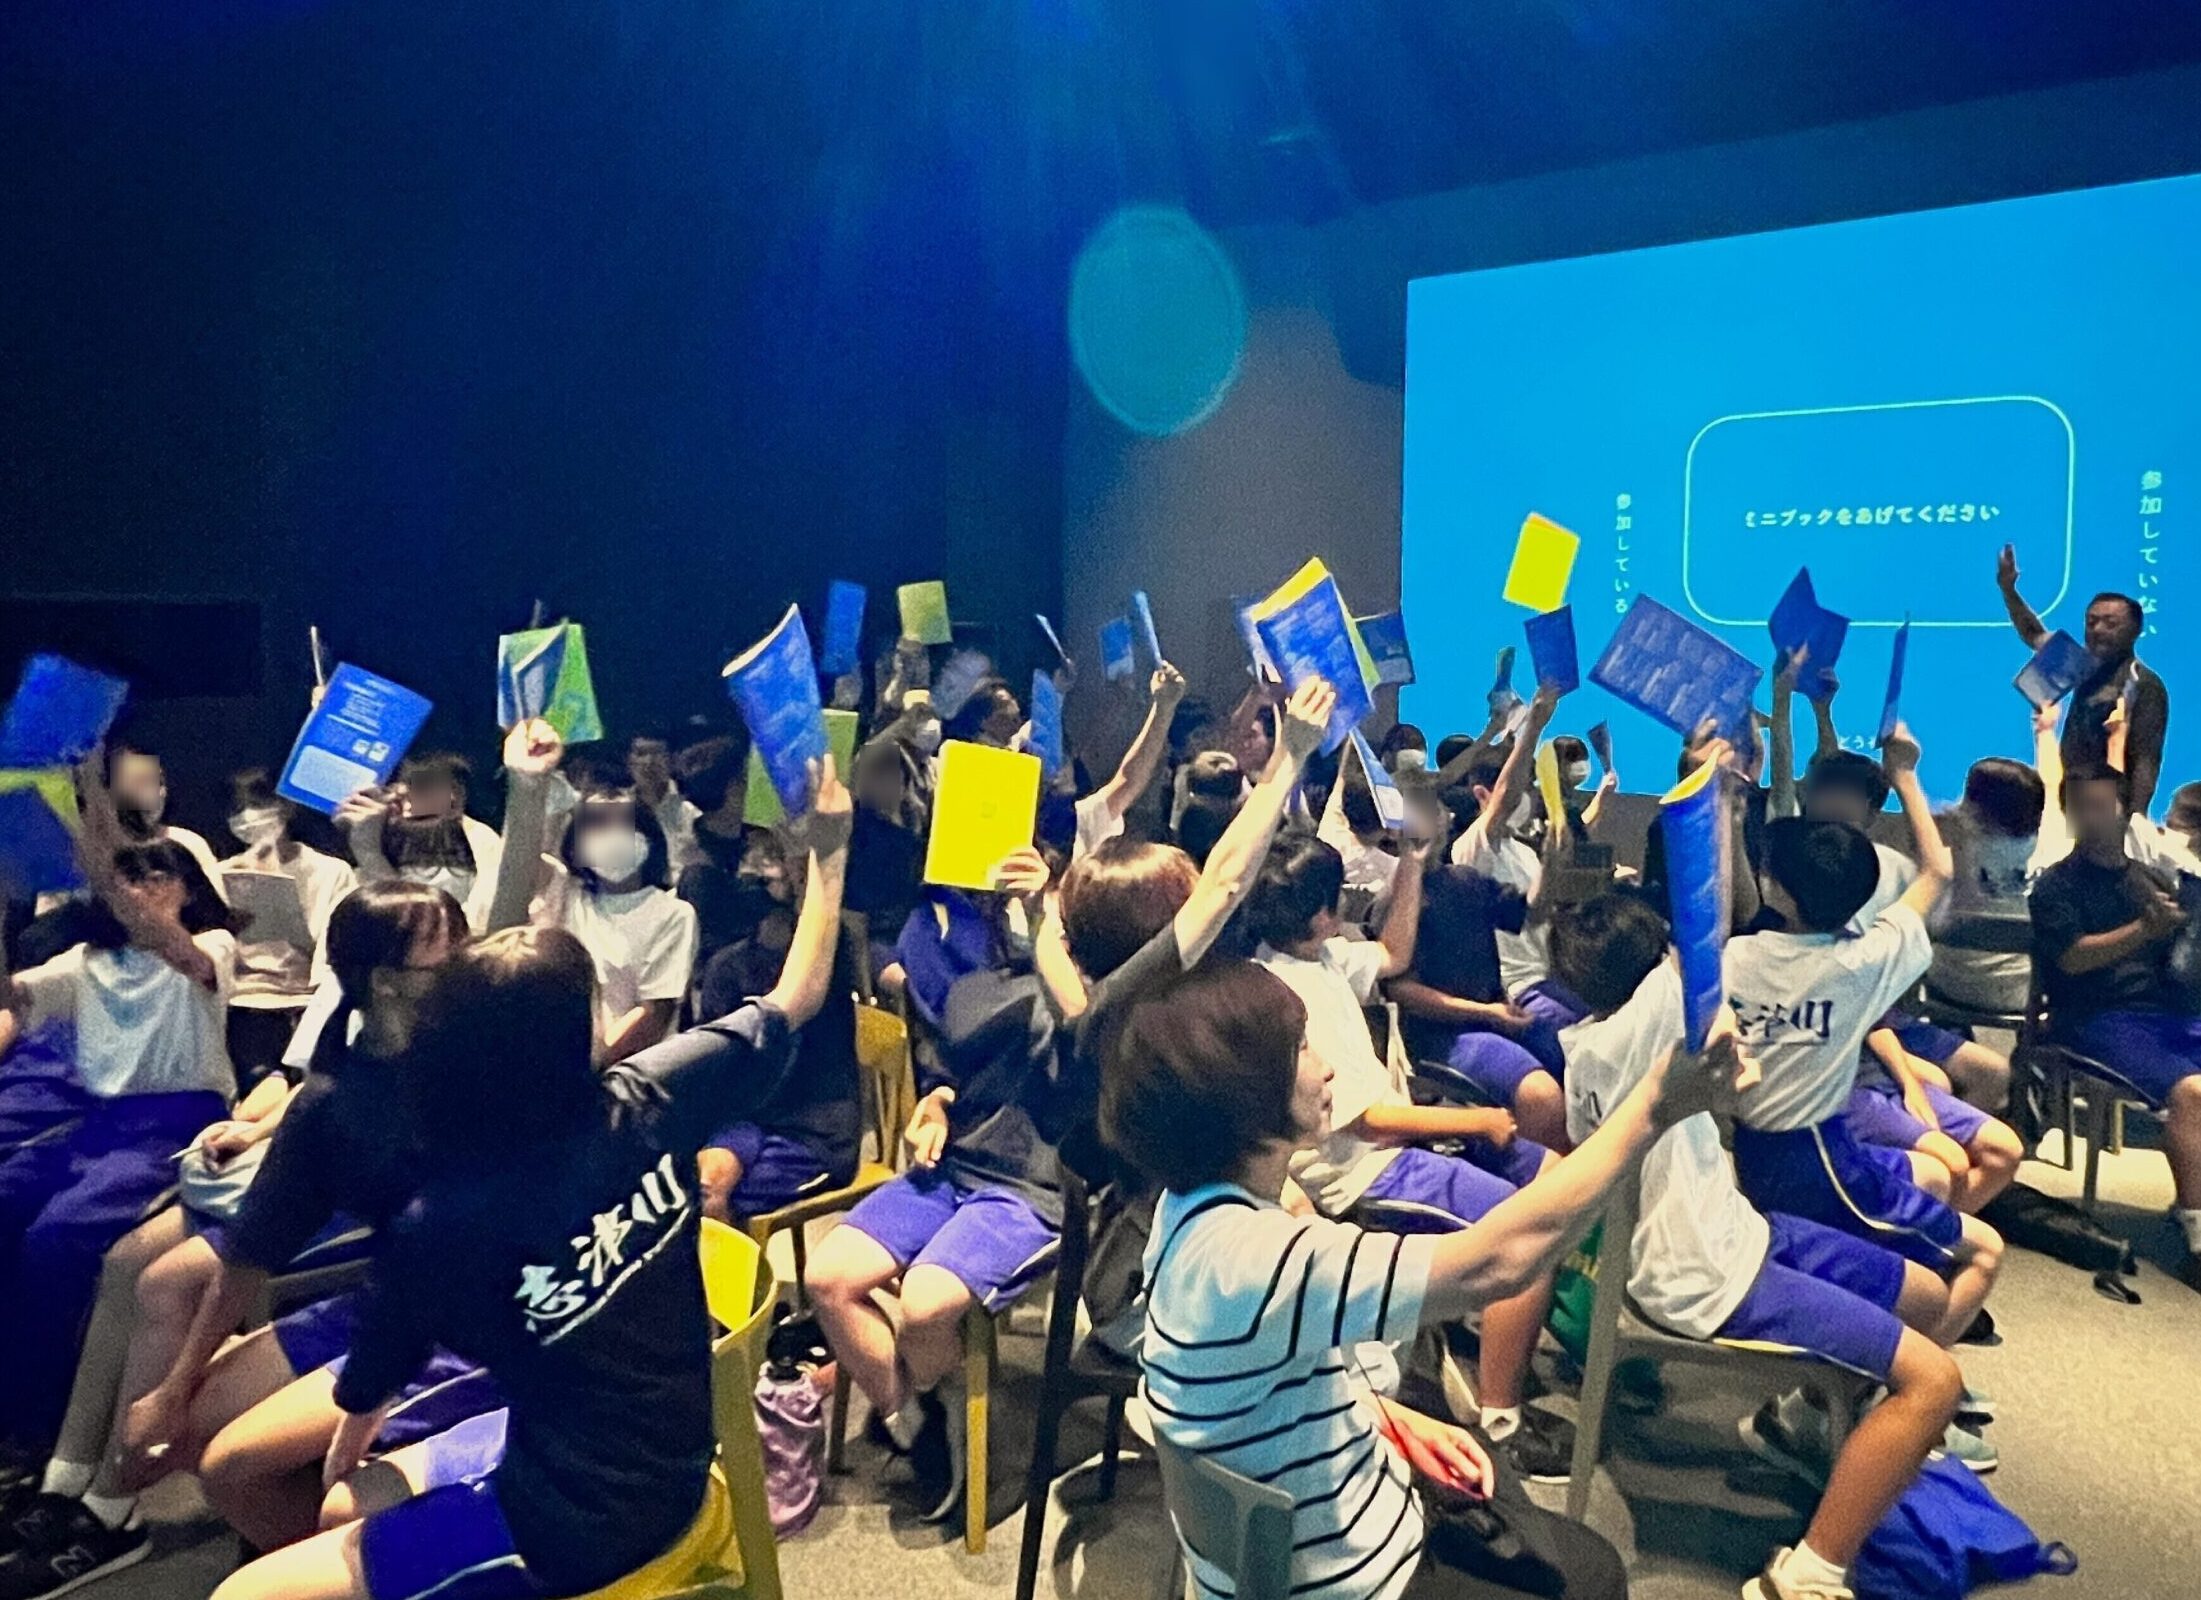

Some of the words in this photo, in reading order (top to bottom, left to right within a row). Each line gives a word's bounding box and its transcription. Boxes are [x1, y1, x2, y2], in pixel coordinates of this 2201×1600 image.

[1745, 505, 2001, 527] ミニブックをあげてください
[1615, 494, 1632, 613] 参加している
